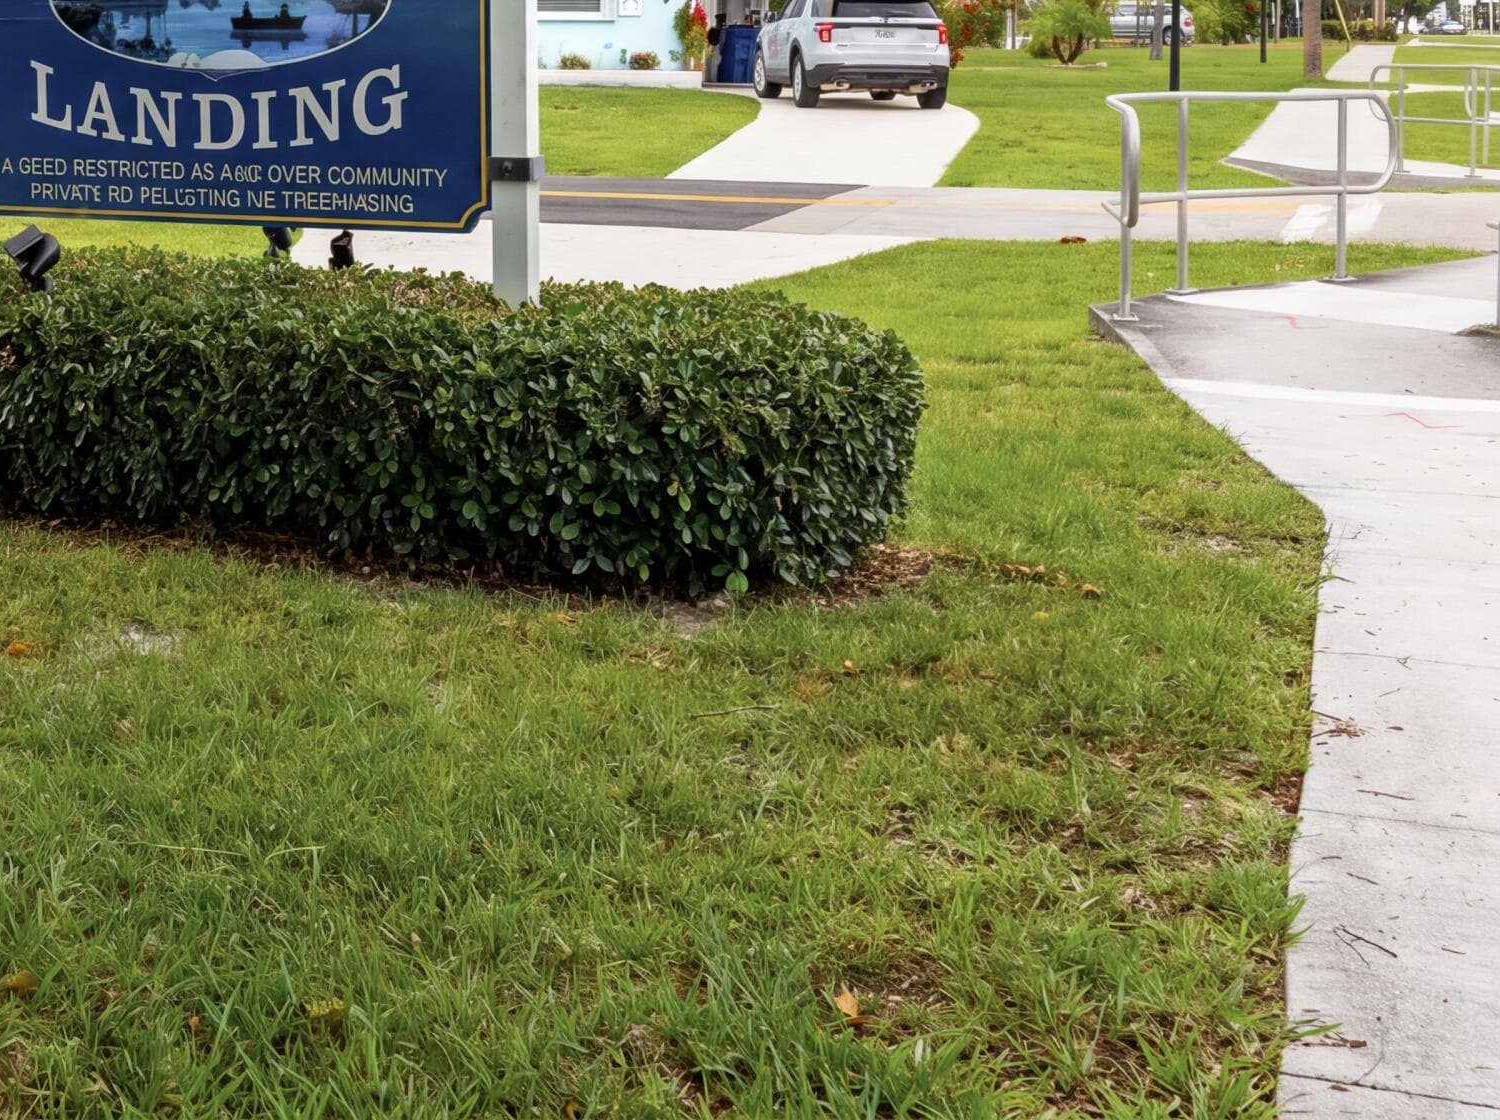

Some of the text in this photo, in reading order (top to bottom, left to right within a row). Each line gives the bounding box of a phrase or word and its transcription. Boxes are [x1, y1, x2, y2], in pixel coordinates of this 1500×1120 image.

[30, 59, 408, 150] LANDING
[1, 157, 14, 174] A
[19, 157, 67, 176] GEED
[73, 159, 185, 179] RESTRICTED
[191, 162, 214, 180] AS
[267, 165, 321, 184] OVER
[327, 166, 448, 187] COMMUNITY
[108, 185, 133, 204] RD
